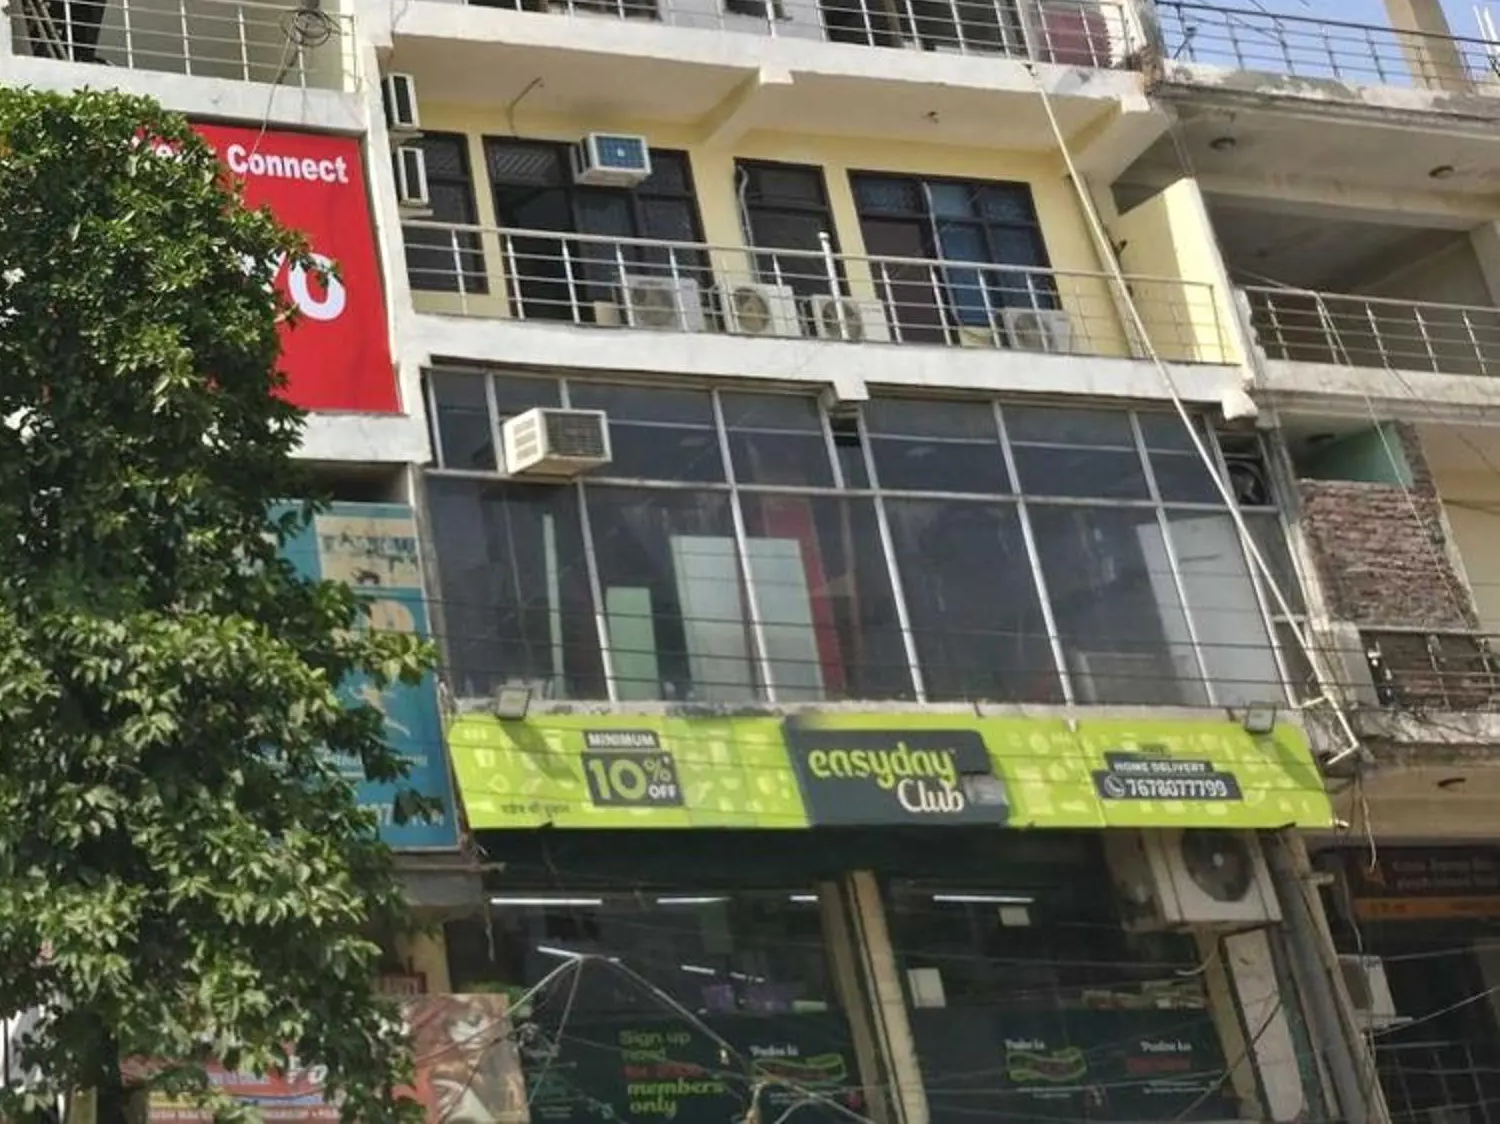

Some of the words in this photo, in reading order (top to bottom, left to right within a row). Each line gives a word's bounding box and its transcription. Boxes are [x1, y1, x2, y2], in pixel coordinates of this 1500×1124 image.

[227, 144, 349, 184] Connect
[588, 733, 655, 747] MINIMUM
[807, 741, 958, 790] easyday
[1113, 760, 1148, 773] HOME
[1151, 761, 1205, 774] DELIVERY
[647, 783, 677, 799] OFF
[896, 778, 965, 813] Club
[1125, 776, 1229, 797] 7678077799
[629, 1096, 678, 1120] only
